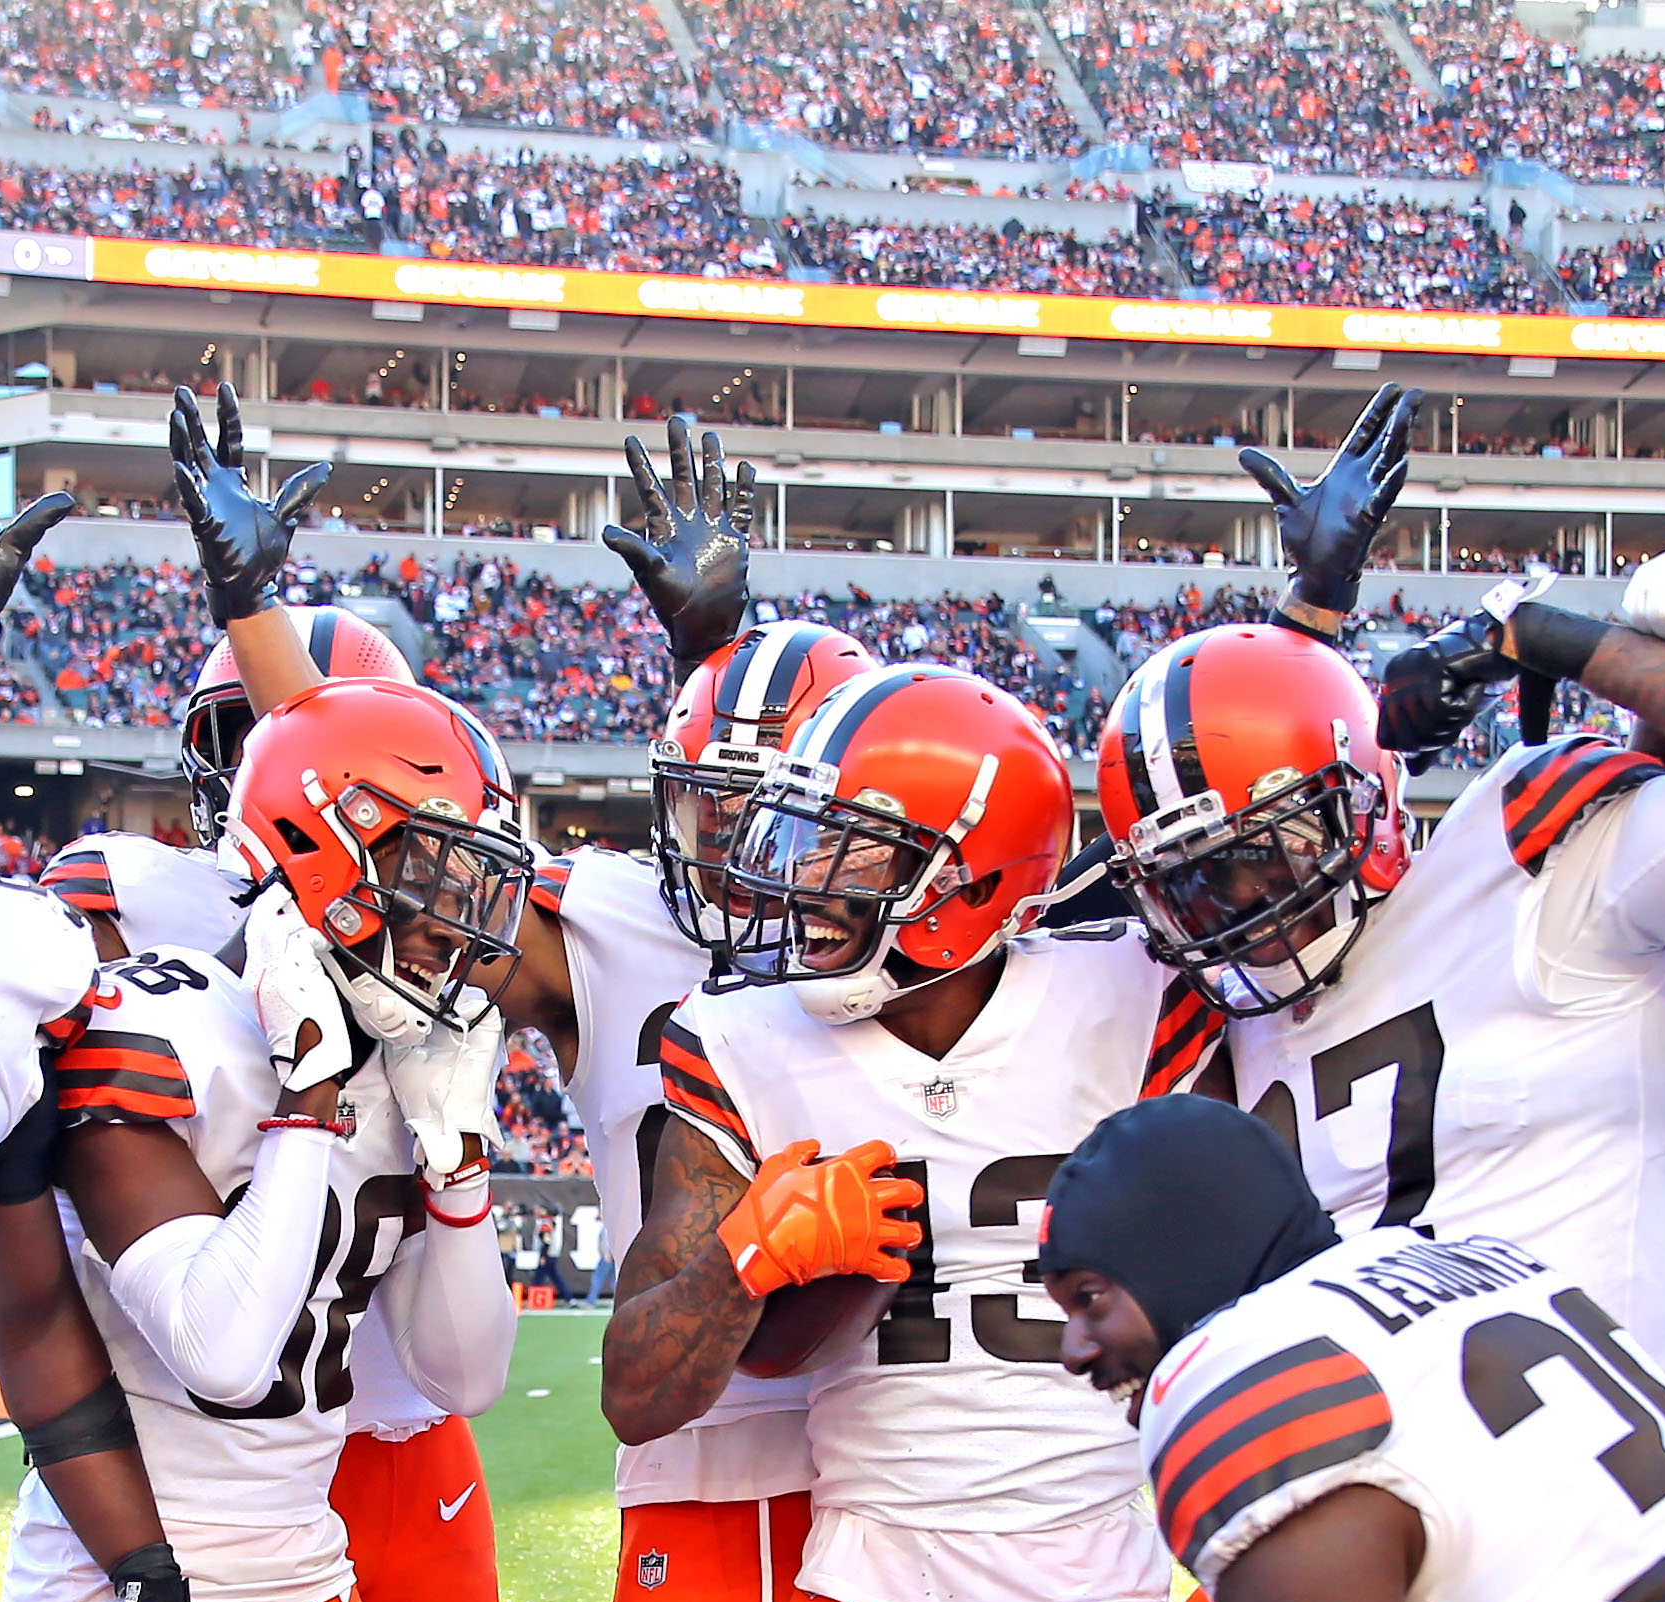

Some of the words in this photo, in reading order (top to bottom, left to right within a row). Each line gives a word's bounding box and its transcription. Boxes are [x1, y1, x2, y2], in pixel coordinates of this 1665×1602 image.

[145, 248, 320, 288] GATORADE
[395, 265, 566, 303] GATORADE
[638, 280, 806, 318] GATORADE
[876, 293, 1041, 328] GATORADE
[1111, 304, 1272, 339] GATORADE
[1343, 314, 1502, 348] GATORADE
[718, 748, 760, 764] BROWNS
[928, 1095, 955, 1112] NFL
[639, 1566, 663, 1584] NFL
